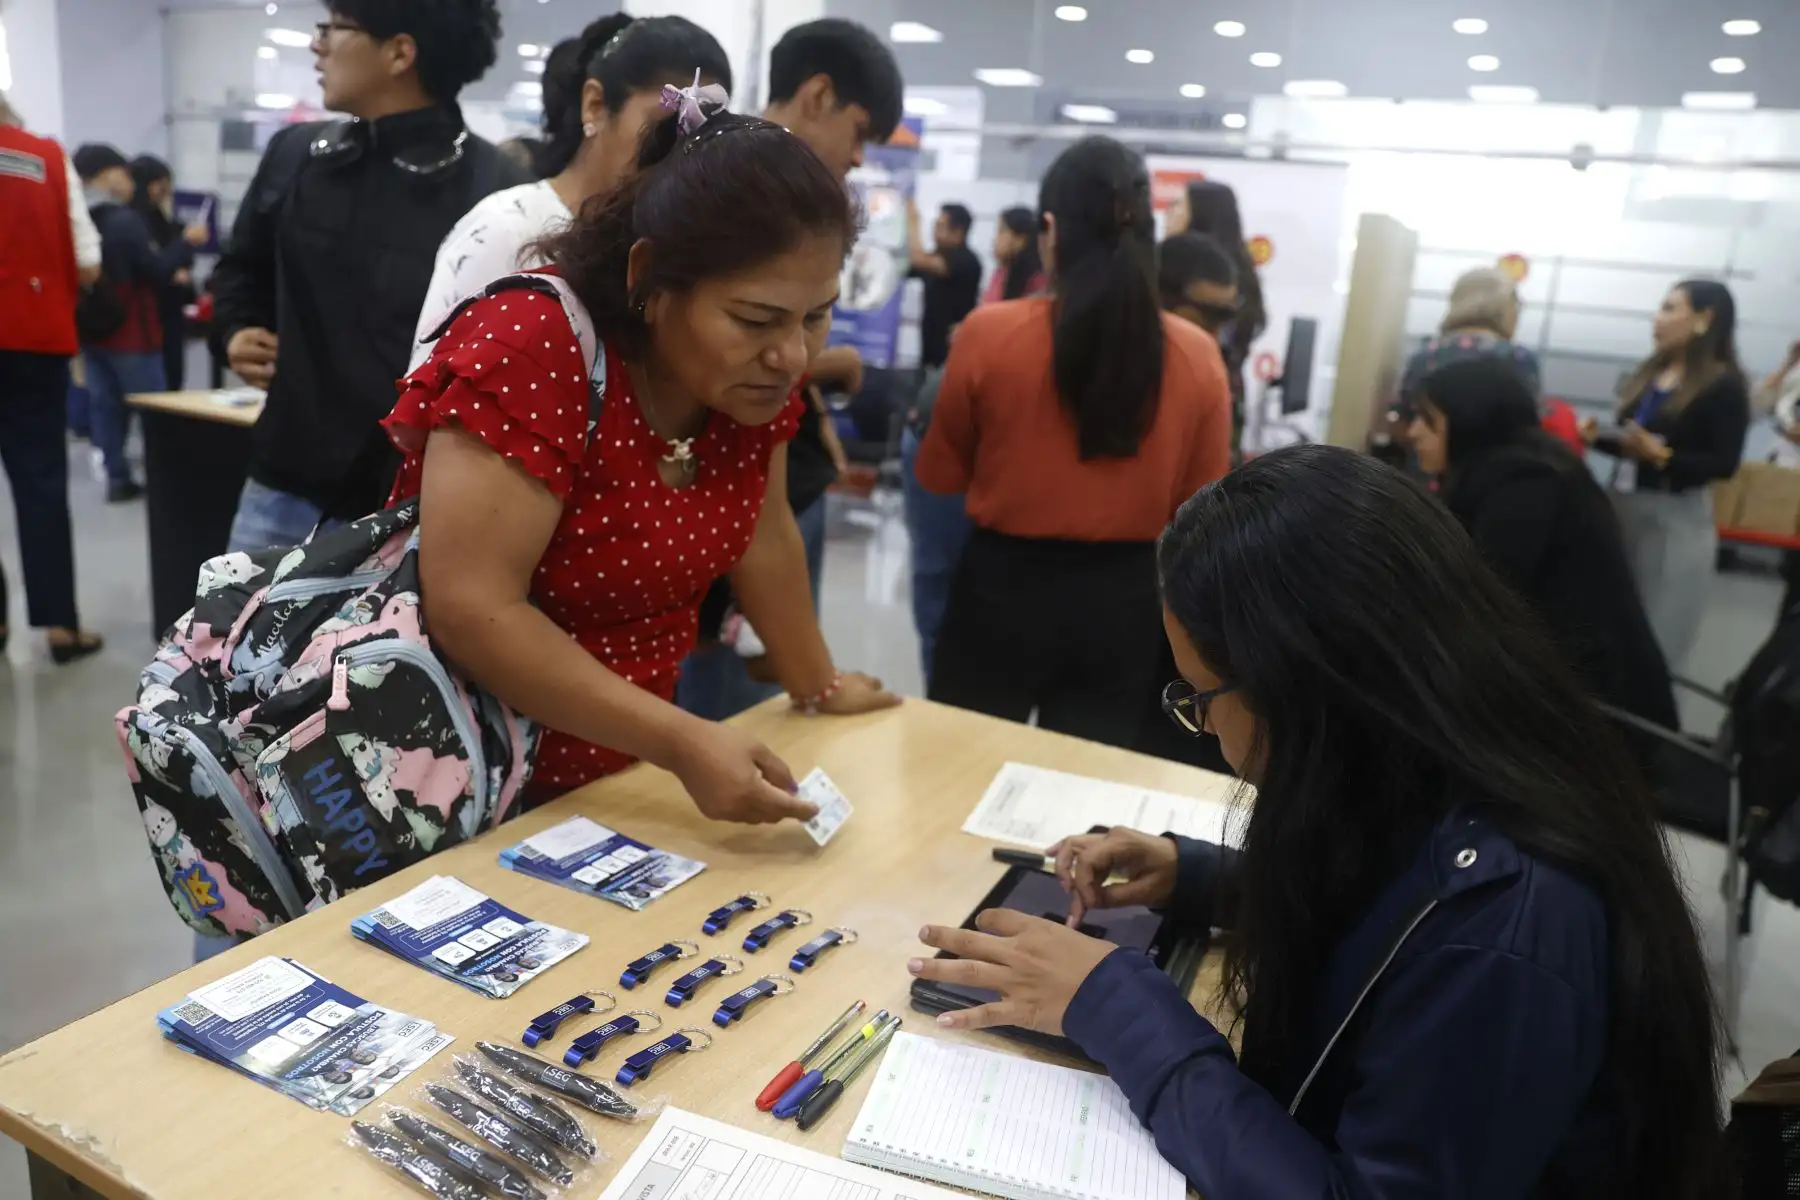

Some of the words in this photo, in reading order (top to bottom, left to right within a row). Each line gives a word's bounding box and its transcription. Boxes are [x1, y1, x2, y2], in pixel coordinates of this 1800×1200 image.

[303, 757, 388, 876] HAPPY
[514, 928, 546, 947] POSTULA
[499, 945, 516, 955] CON
[461, 953, 501, 976] NOSOTROS
[346, 1013, 382, 1036] POSTULA
[328, 1036, 348, 1048] CON
[283, 1047, 330, 1078] NOSOTROS
[309, 1046, 348, 1071] CHAMBA?
